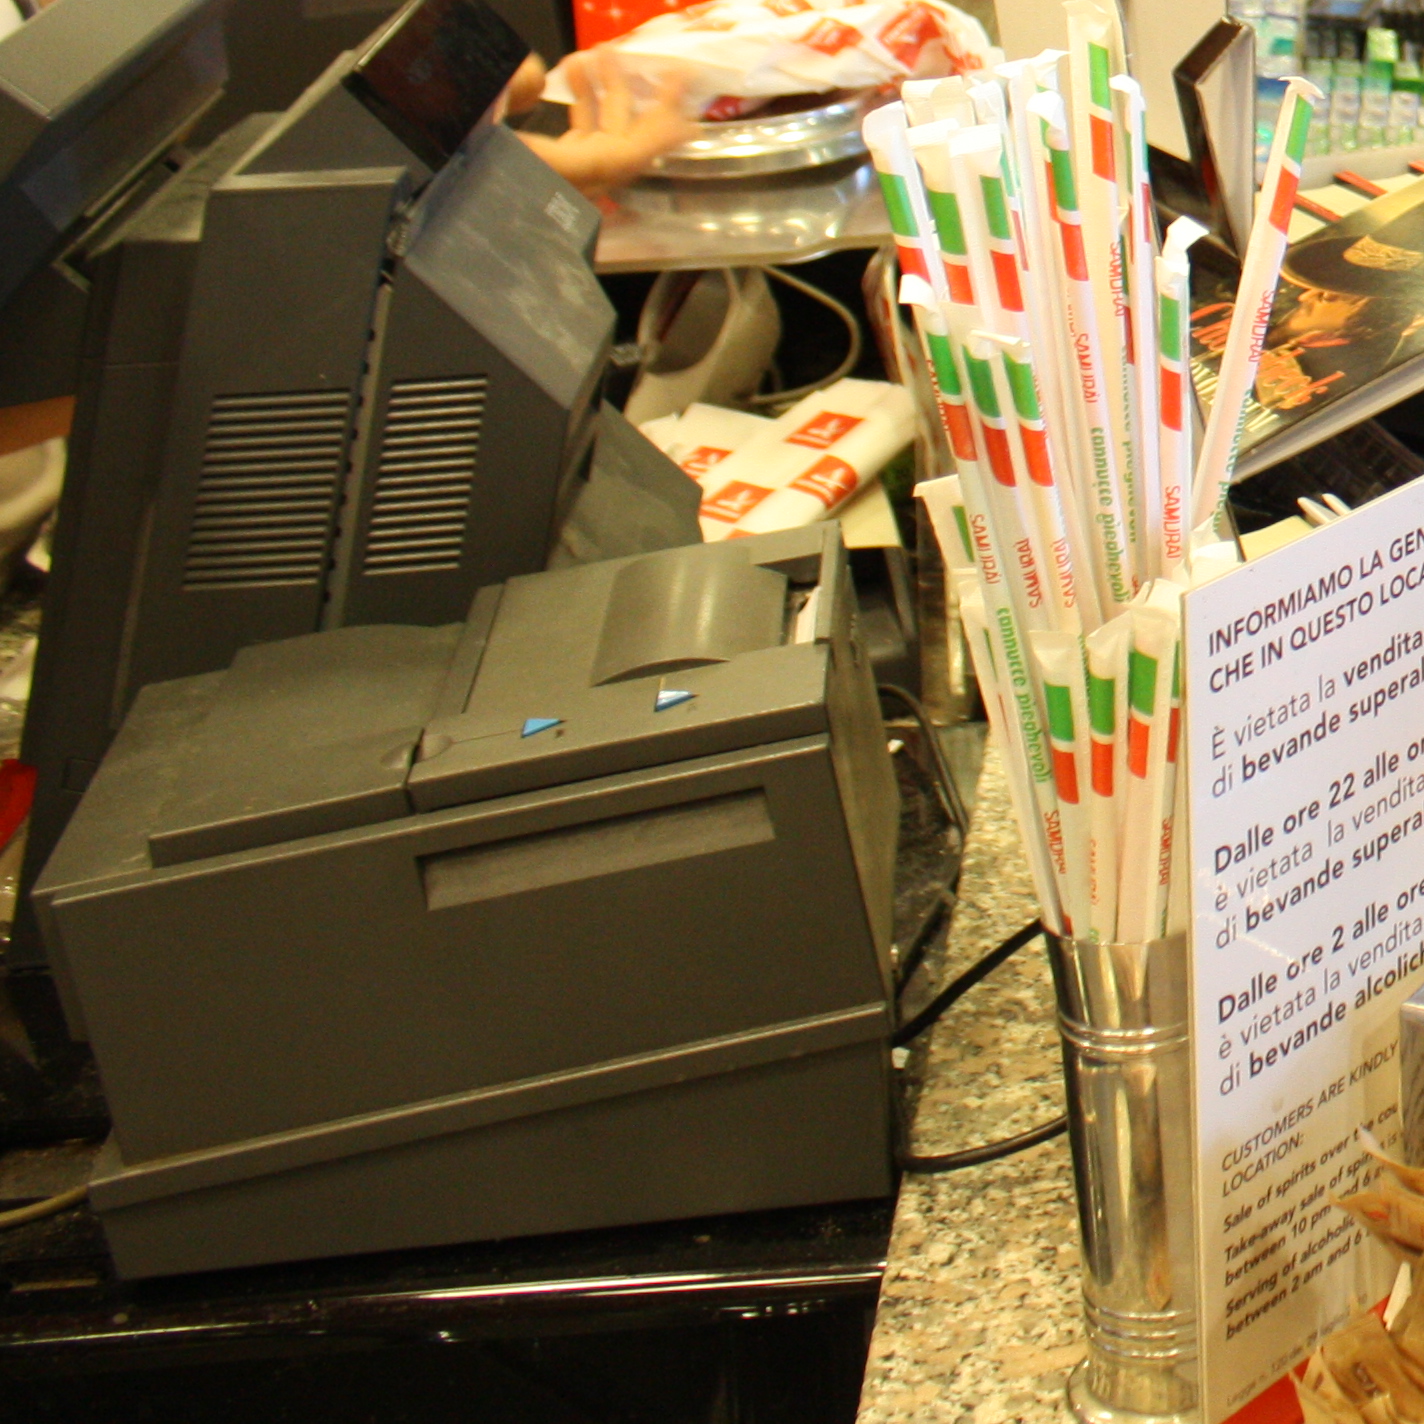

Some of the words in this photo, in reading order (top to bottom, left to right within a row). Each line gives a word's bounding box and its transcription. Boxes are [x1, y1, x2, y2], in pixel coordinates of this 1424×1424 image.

[1248, 290, 1275, 363] SAMURAI
[1092, 427, 1113, 507] cannucce
[1164, 485, 1181, 560] SAMURAI
[1208, 565, 1353, 657] INFORMIAMO
[1359, 549, 1384, 581] LA
[1209, 652, 1255, 695] CHE
[1261, 636, 1285, 670] IN
[1290, 591, 1374, 652] QUESTO
[996, 607, 1027, 687] cannucce
[1016, 689, 1053, 784] pieghevoli
[1211, 725, 1226, 761] È
[1233, 691, 1310, 748] vietata
[1318, 673, 1336, 703] la
[1343, 628, 1424, 688] vendita
[1211, 765, 1233, 799] di
[1241, 709, 1341, 784] bevande
[1214, 826, 1274, 876] Dalle
[1283, 799, 1320, 835] ore
[1328, 772, 1355, 809] 22
[1363, 751, 1399, 789] alle
[1214, 885, 1228, 913] è
[1236, 840, 1313, 900] vietata
[1327, 819, 1345, 847] la
[1215, 917, 1238, 950] di
[1245, 859, 1345, 934] bevande
[1217, 972, 1278, 1026] Dalle
[1286, 944, 1324, 981] ore
[1331, 926, 1346, 954] 2
[1352, 900, 1389, 942] alle
[1218, 1033, 1232, 1061] è
[1240, 985, 1317, 1047] vietata
[1323, 968, 1341, 996] la
[1347, 917, 1424, 979] vendita
[1219, 1063, 1241, 1097] di
[1249, 1000, 1347, 1079] bevande
[1221, 1097, 1315, 1173] CUSTOMERS
[1317, 1075, 1346, 1107] ARE
[1349, 1039, 1399, 1087] KINDLY
[1222, 1131, 1305, 1198] LOCATION:
[1223, 1204, 1252, 1234] Sale
[1256, 1185, 1273, 1210] of
[1275, 1161, 1317, 1201] spirits
[1319, 1139, 1351, 1166] over
[1224, 1204, 1297, 1264] Take-away
[1299, 1183, 1325, 1211] sale
[1329, 1166, 1345, 1190] of
[1225, 1235, 1287, 1288] between
[1291, 1217, 1307, 1239] 10
[1310, 1204, 1332, 1231] pm
[1225, 1271, 1278, 1319] Serving
[1282, 1252, 1298, 1278] of
[1226, 1288, 1287, 1341] between
[1291, 1275, 1301, 1294] 2
[1303, 1260, 1324, 1286] am
[1326, 1239, 1352, 1267] and
